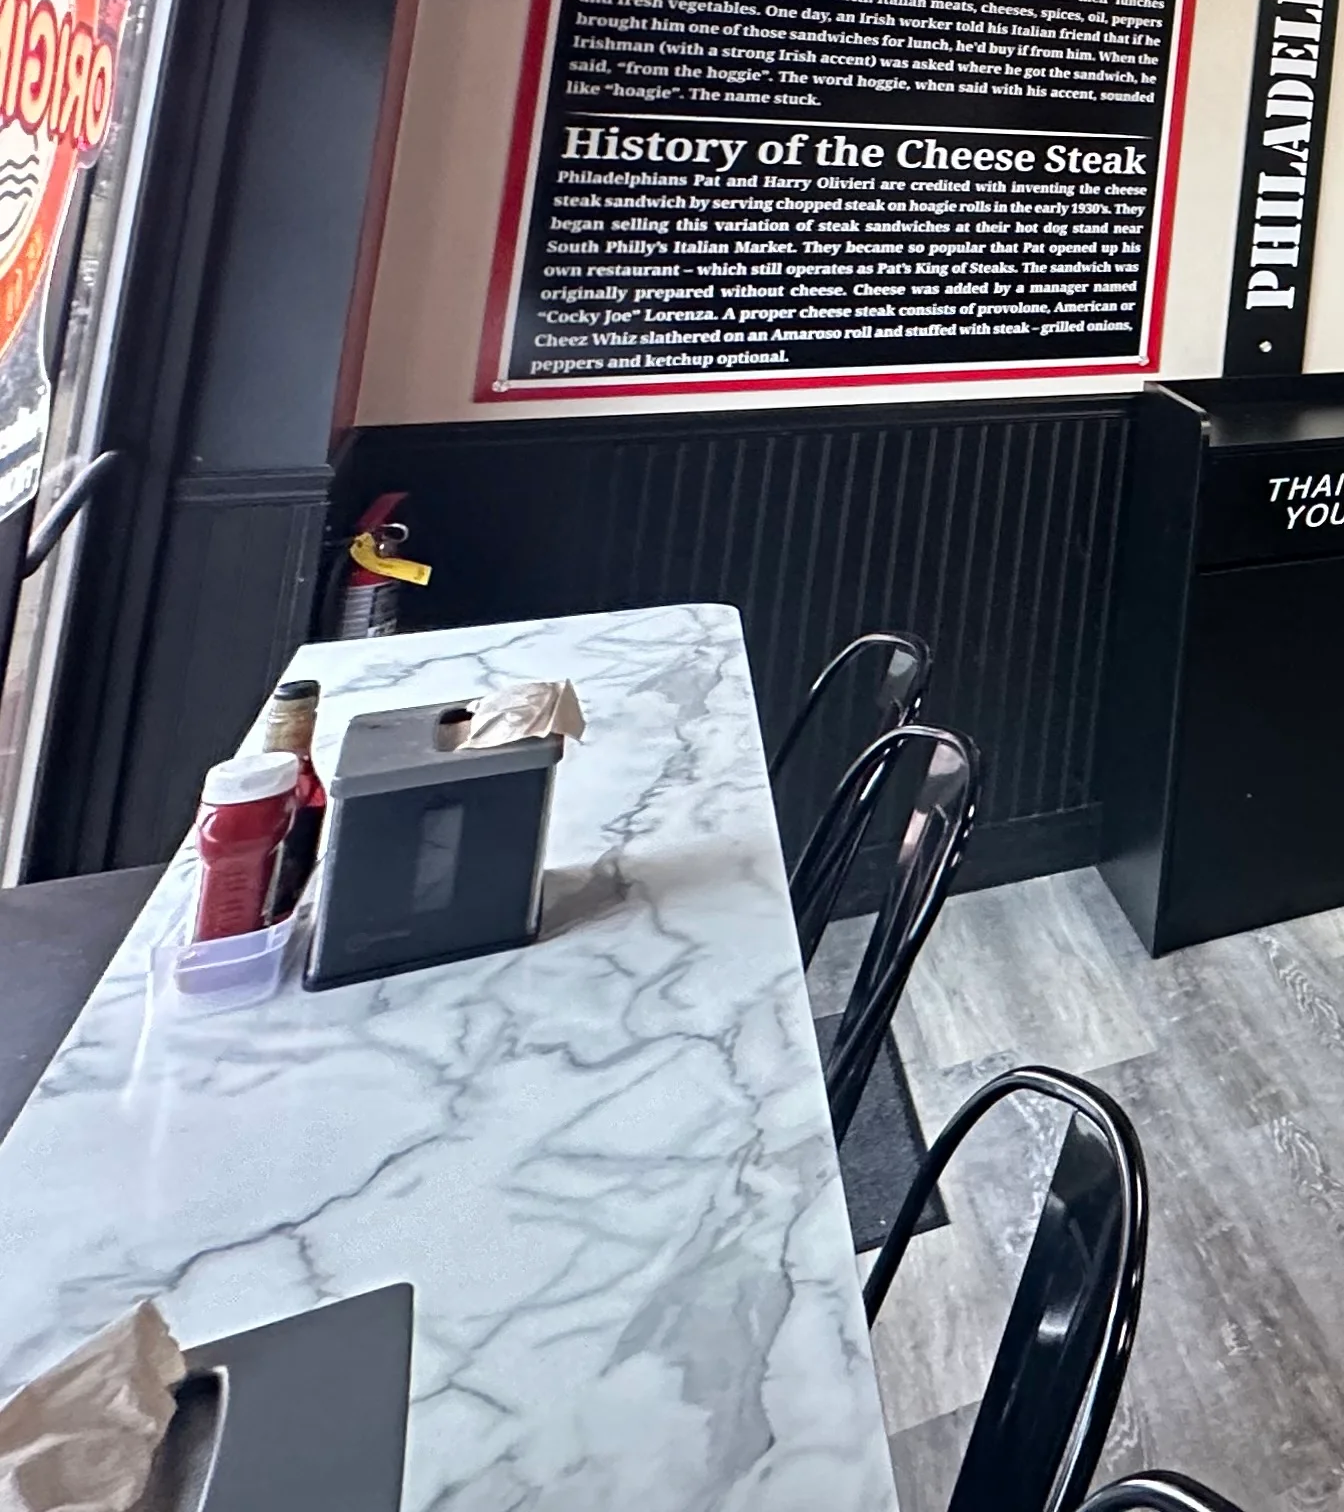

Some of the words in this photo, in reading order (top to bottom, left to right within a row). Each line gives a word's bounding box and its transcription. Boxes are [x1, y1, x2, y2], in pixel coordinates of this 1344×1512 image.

[668, 0, 761, 16] vegetables.
[765, 5, 798, 19] One
[800, 7, 832, 24] day,
[835, 12, 856, 23] an
[858, 12, 896, 26] Irish
[899, 17, 953, 31] worker
[955, 20, 985, 33] told
[987, 21, 1009, 35] his
[1010, 24, 1057, 39] Italian
[1058, 27, 1101, 42] friend
[1103, 31, 1130, 45] that
[1131, 33, 1144, 45] if
[1144, 34, 1161, 47] he
[930, 0, 978, 14] meats,
[980, 2, 1038, 19] cheeses,
[1040, 7, 1085, 23] spices,
[1087, 11, 1109, 25] oil,
[1111, 15, 1163, 29] peppers
[566, 80, 601, 95] like
[688, 87, 721, 101] The
[723, 92, 771, 104] name
[773, 93, 822, 106] stuck.
[561, 126, 748, 172] History
[758, 133, 810, 165] of
[815, 135, 885, 168] the
[896, 138, 1036, 172] Cheese
[1044, 144, 1147, 175] Steak
[557, 170, 688, 189] Philadelphians
[693, 174, 721, 187] Pat
[726, 174, 758, 188] and
[762, 175, 812, 192] Harry
[816, 176, 875, 190] Olivieri
[879, 180, 906, 191] are
[910, 179, 971, 192] credited
[974, 180, 1007, 193] with
[1010, 180, 1076, 197] inventing
[1079, 182, 1101, 195] the
[1104, 183, 1148, 196] cheese
[550, 216, 604, 233] began
[611, 217, 670, 234] selling
[676, 217, 708, 231] this
[714, 218, 790, 232] variation
[795, 219, 815, 232] of
[817, 219, 860, 232] steak
[864, 219, 951, 233] sandwiches
[955, 222, 971, 233] at
[975, 220, 1011, 233] their
[1014, 221, 1039, 233] hot
[1042, 221, 1069, 237] dog
[1072, 222, 1109, 234] stand
[1112, 224, 1144, 234] near
[546, 240, 599, 253] South
[672, 240, 729, 254] Italian
[733, 240, 798, 254] Market.
[802, 240, 842, 256] They
[844, 240, 904, 254] became
[907, 243, 925, 253] so
[927, 241, 987, 257] popular
[990, 241, 1019, 254] that
[1022, 242, 1045, 254] Pat
[1048, 241, 1098, 257] opened
[1101, 244, 1119, 257] up
[1121, 241, 1141, 253] his
[540, 286, 628, 303] originally
[633, 284, 714, 303] prepared
[720, 284, 785, 298] without
[789, 283, 847, 297] cheese.
[852, 283, 906, 296] Cheese
[911, 285, 940, 295] was
[944, 281, 989, 295] added
[993, 282, 1012, 297] by
[1015, 284, 1025, 294] a
[1029, 283, 1090, 296] manager
[1093, 280, 1138, 292] named
[530, 358, 604, 375] peppers
[606, 354, 642, 369] and
[643, 352, 714, 369] ketchup
[716, 349, 789, 368] optional.
